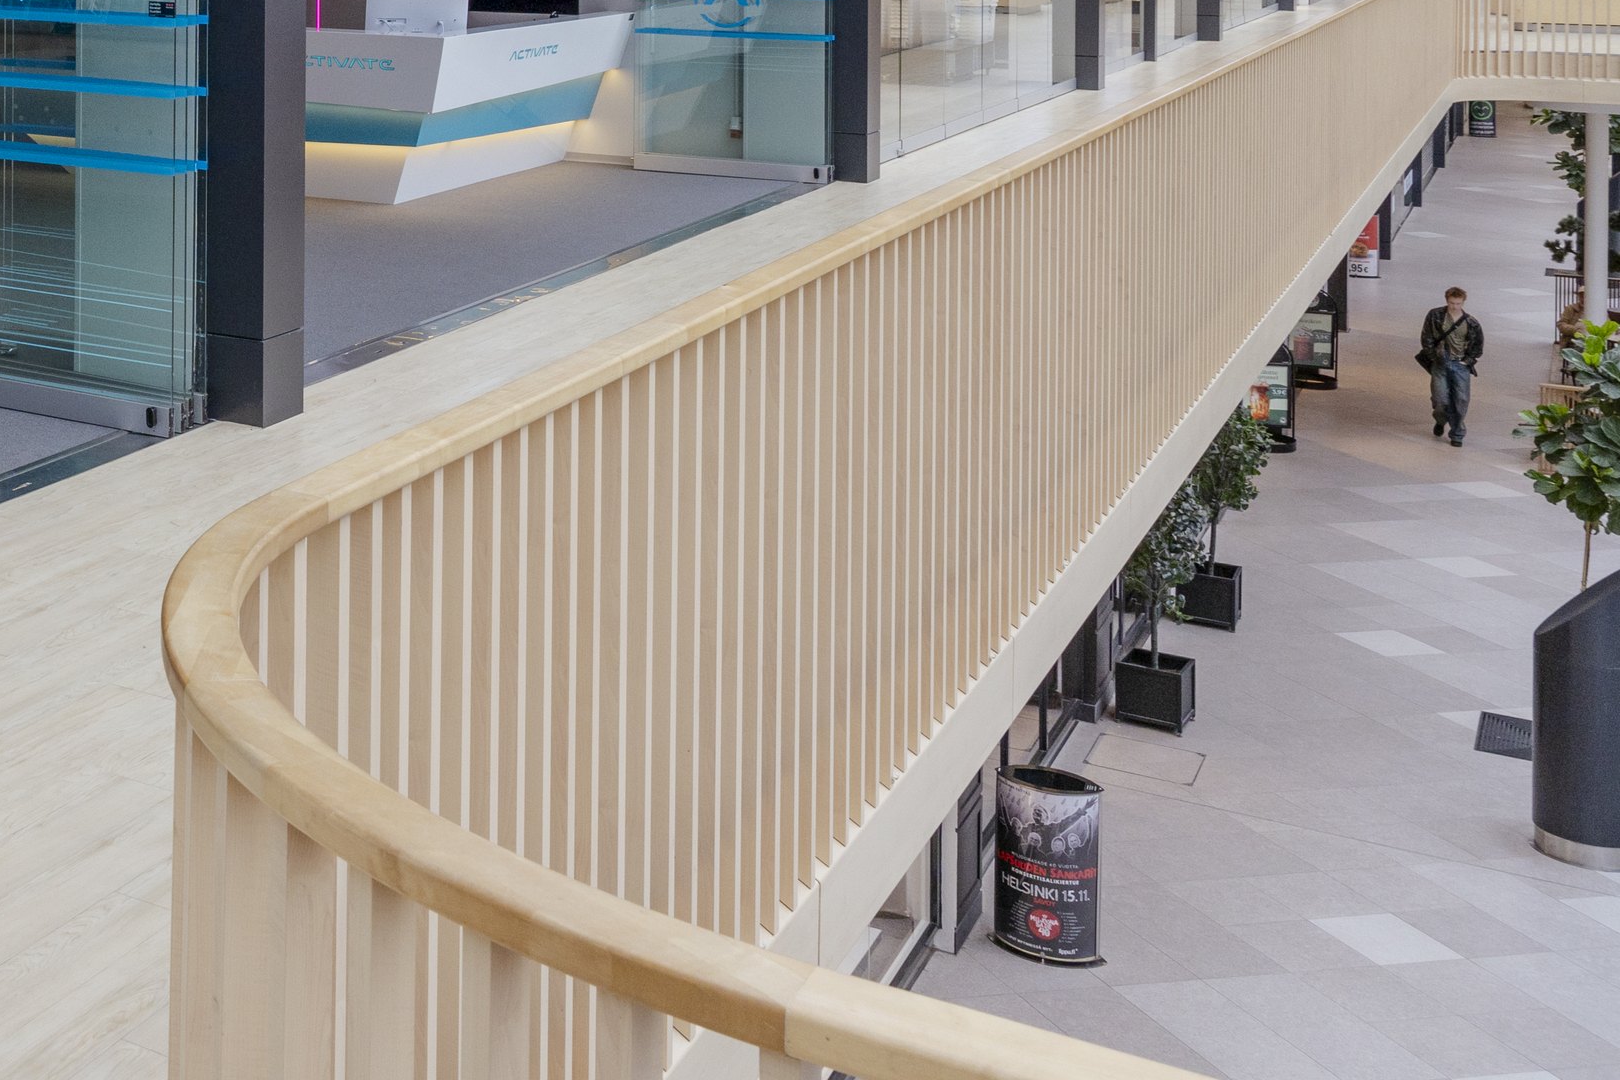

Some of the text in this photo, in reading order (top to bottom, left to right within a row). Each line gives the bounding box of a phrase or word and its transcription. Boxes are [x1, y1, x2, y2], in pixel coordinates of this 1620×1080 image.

[508, 44, 559, 62] ACTIVATE
[1001, 870, 1091, 903] HELSINKI 15.11.
